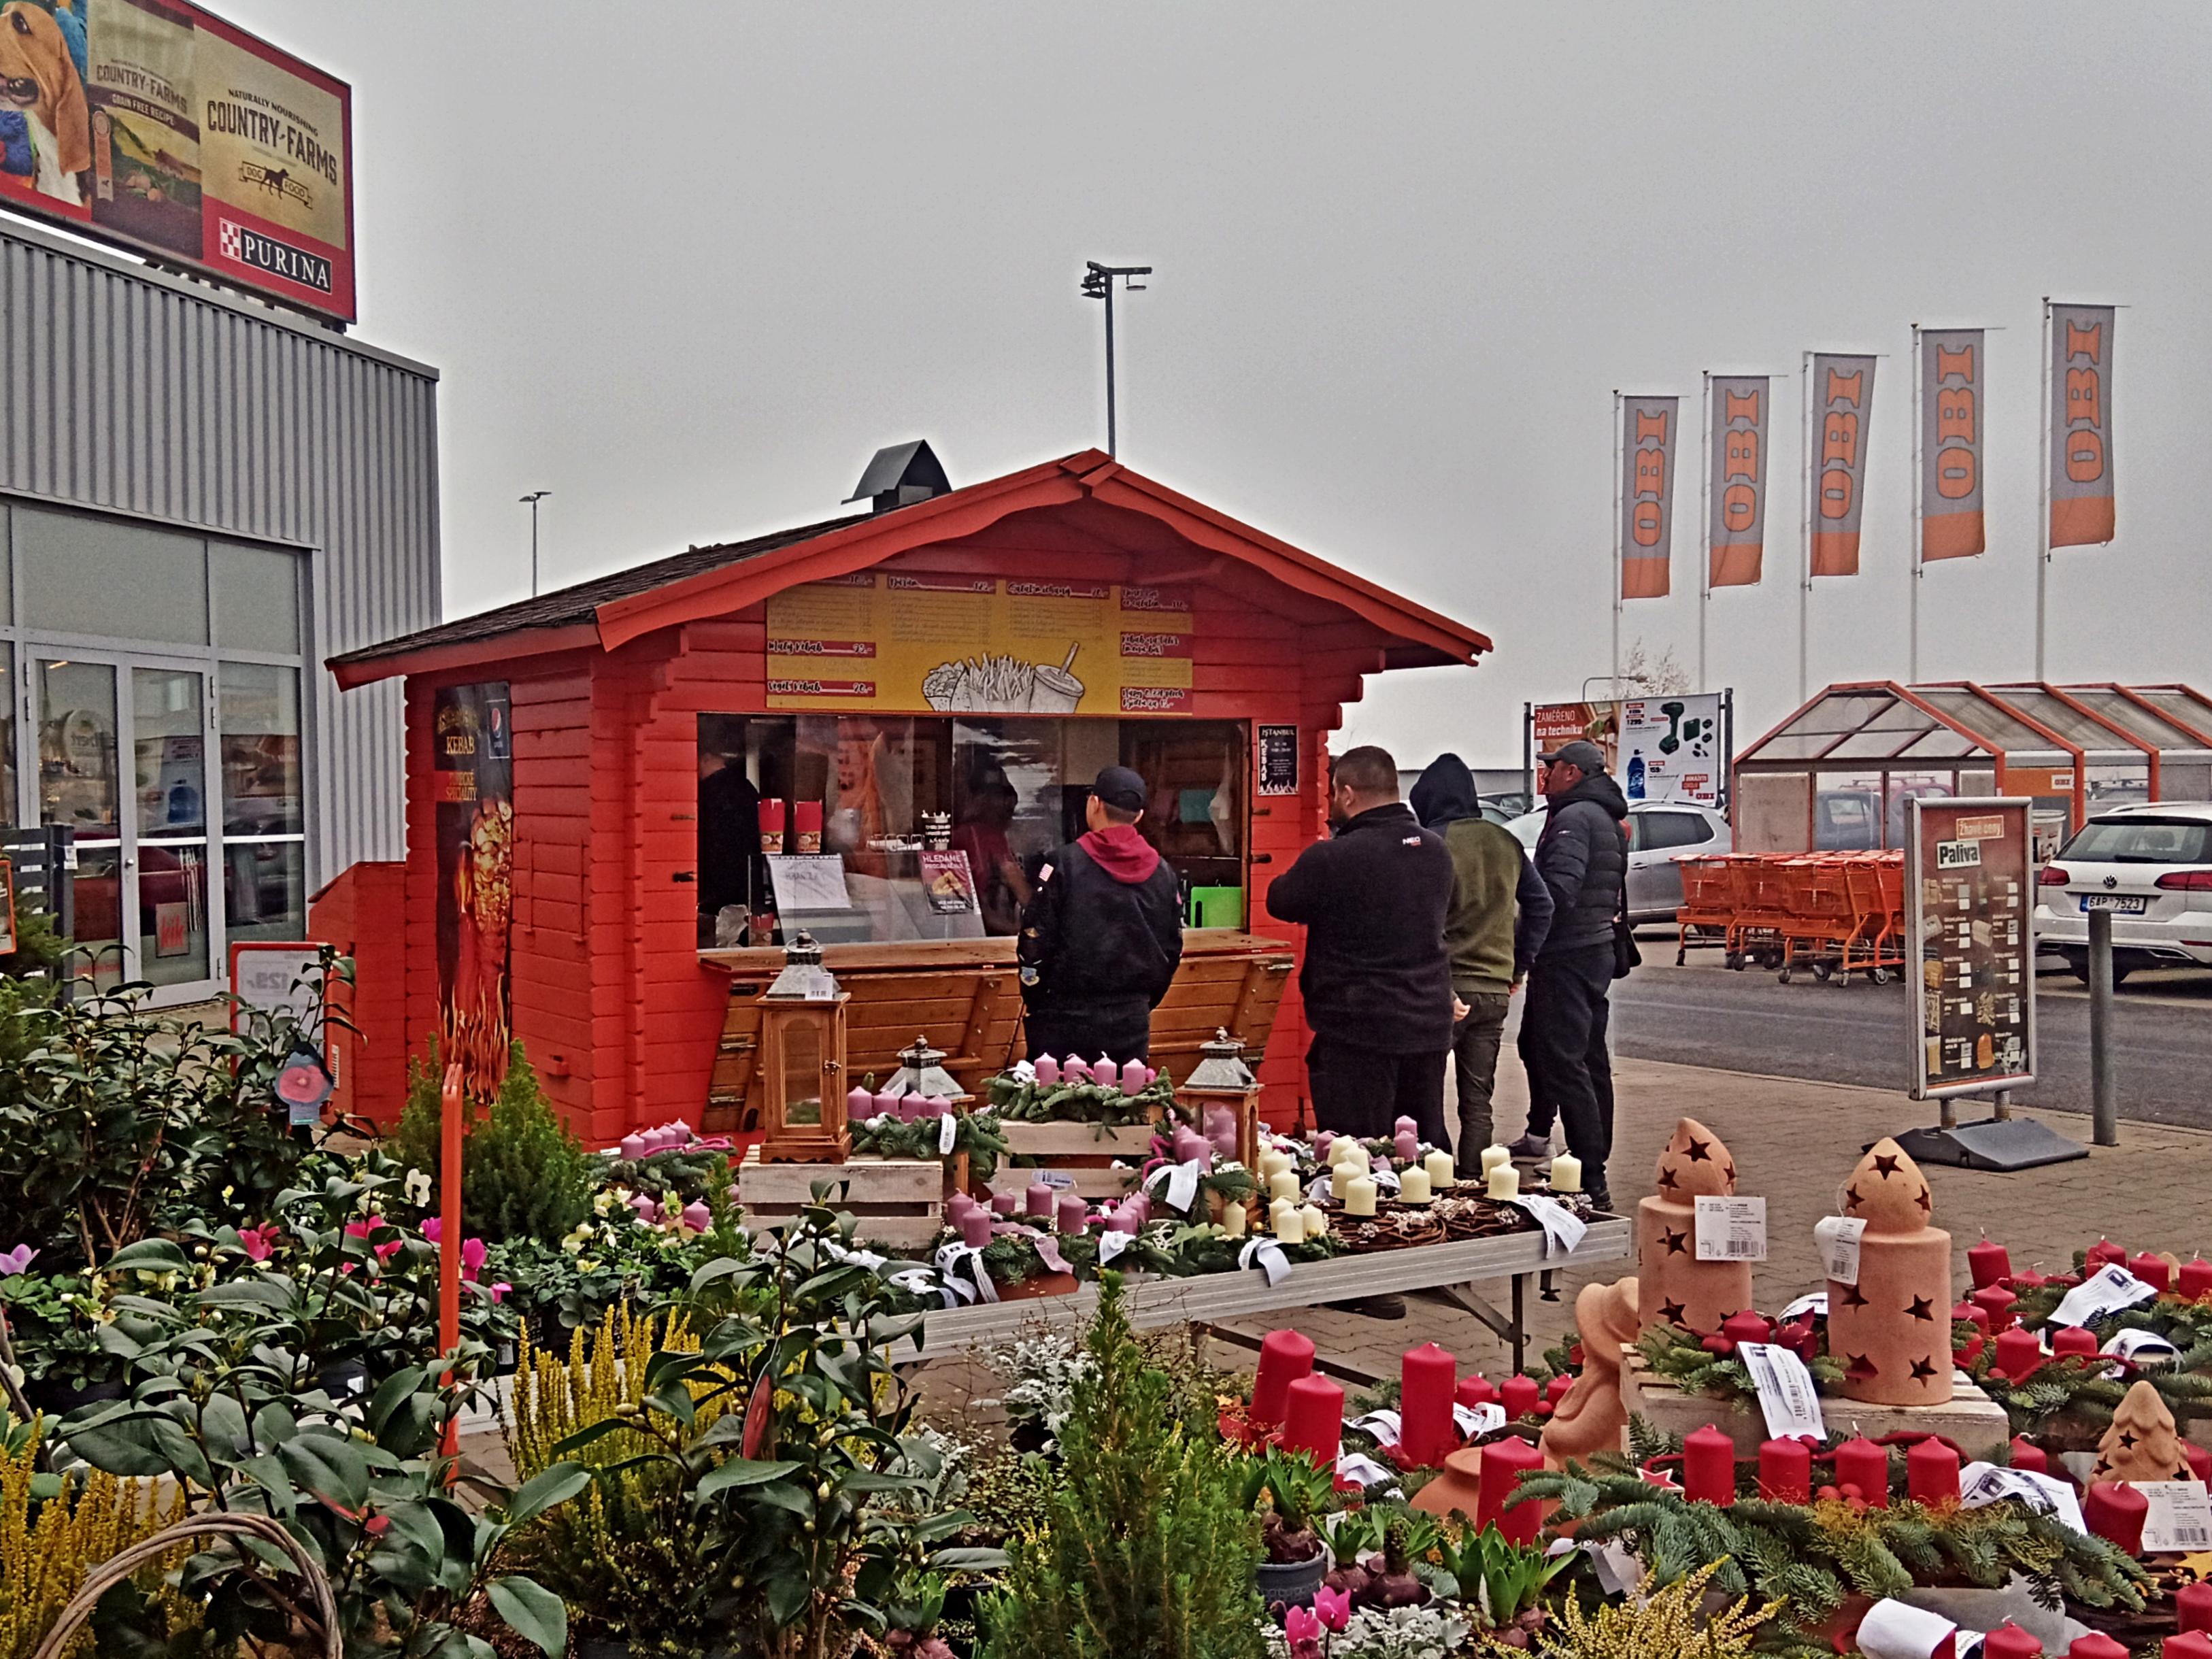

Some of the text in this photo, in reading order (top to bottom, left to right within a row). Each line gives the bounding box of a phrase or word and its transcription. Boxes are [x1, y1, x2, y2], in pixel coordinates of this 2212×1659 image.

[96, 65, 146, 90] COUNTRY
[150, 78, 188, 114] FARMS
[132, 99, 149, 116] FREE
[150, 105, 175, 126] RECIPE
[229, 89, 318, 137] NATURALLY NOURISHING
[207, 99, 338, 186] COUNTRY FARMS
[246, 166, 305, 198] DOG FOOD
[244, 234, 329, 288] PURINA
[1935, 343, 1976, 500] OBI
[2064, 318, 2104, 483] OBI
[1722, 389, 1760, 533] OBI
[1819, 367, 1864, 520] OBI
[1632, 408, 1669, 547] OBI
[1536, 709, 1576, 723] ZAMĚŘENO
[1536, 724, 1583, 737] na techniku
[446, 735, 475, 755] KEBAB
[1260, 738, 1269, 782] KEBAB
[922, 852, 961, 863] HLEDÁME
[1939, 843, 1978, 865] Paliva
[2089, 896, 2140, 909] 6AP 7523
[161, 915, 186, 948] kik
